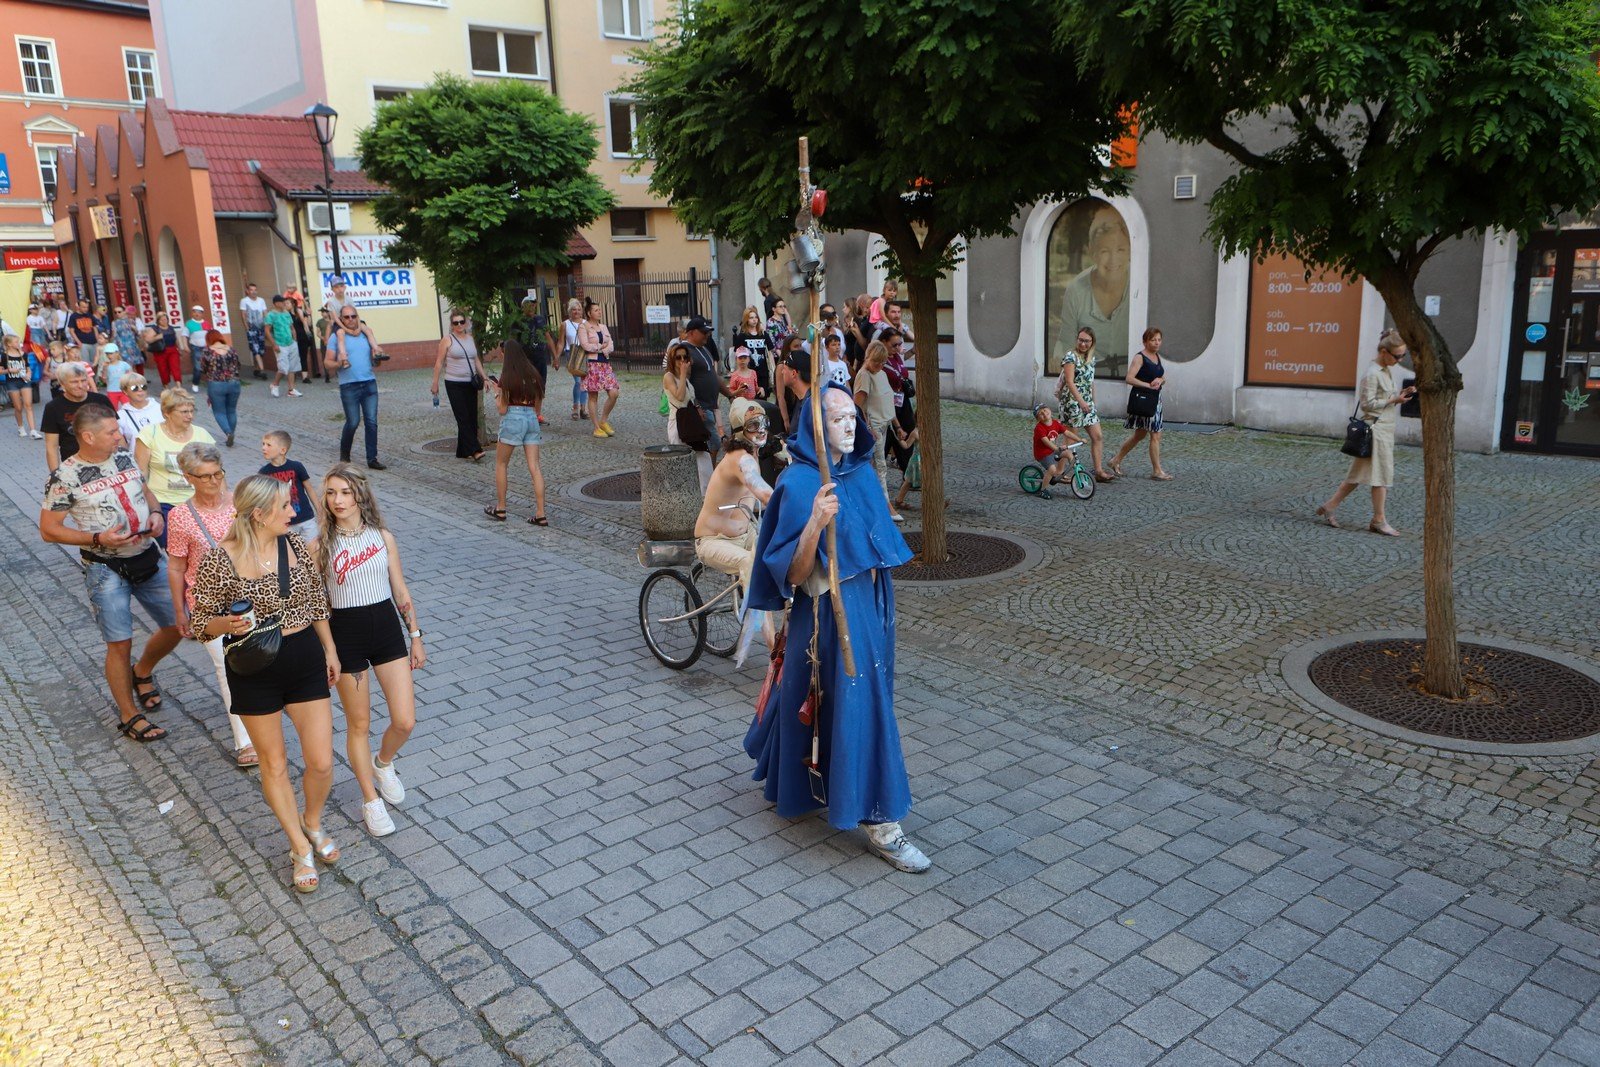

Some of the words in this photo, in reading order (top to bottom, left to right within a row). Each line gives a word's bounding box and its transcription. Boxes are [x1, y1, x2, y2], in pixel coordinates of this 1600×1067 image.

[322, 269, 412, 288] KANTOR
[379, 289, 413, 298] WALUT
[1268, 282, 1292, 294] 8:00
[1310, 282, 1342, 293] 20:00
[210, 275, 228, 327] KANTOR
[1266, 309, 1286, 319] sob.
[1266, 321, 1290, 332] 8:00
[1308, 322, 1340, 333] 17:00
[1265, 348, 1279, 357] nd.
[1264, 359, 1324, 374] nieczynne
[106, 474, 125, 489] AND
[334, 543, 386, 586] Guess
